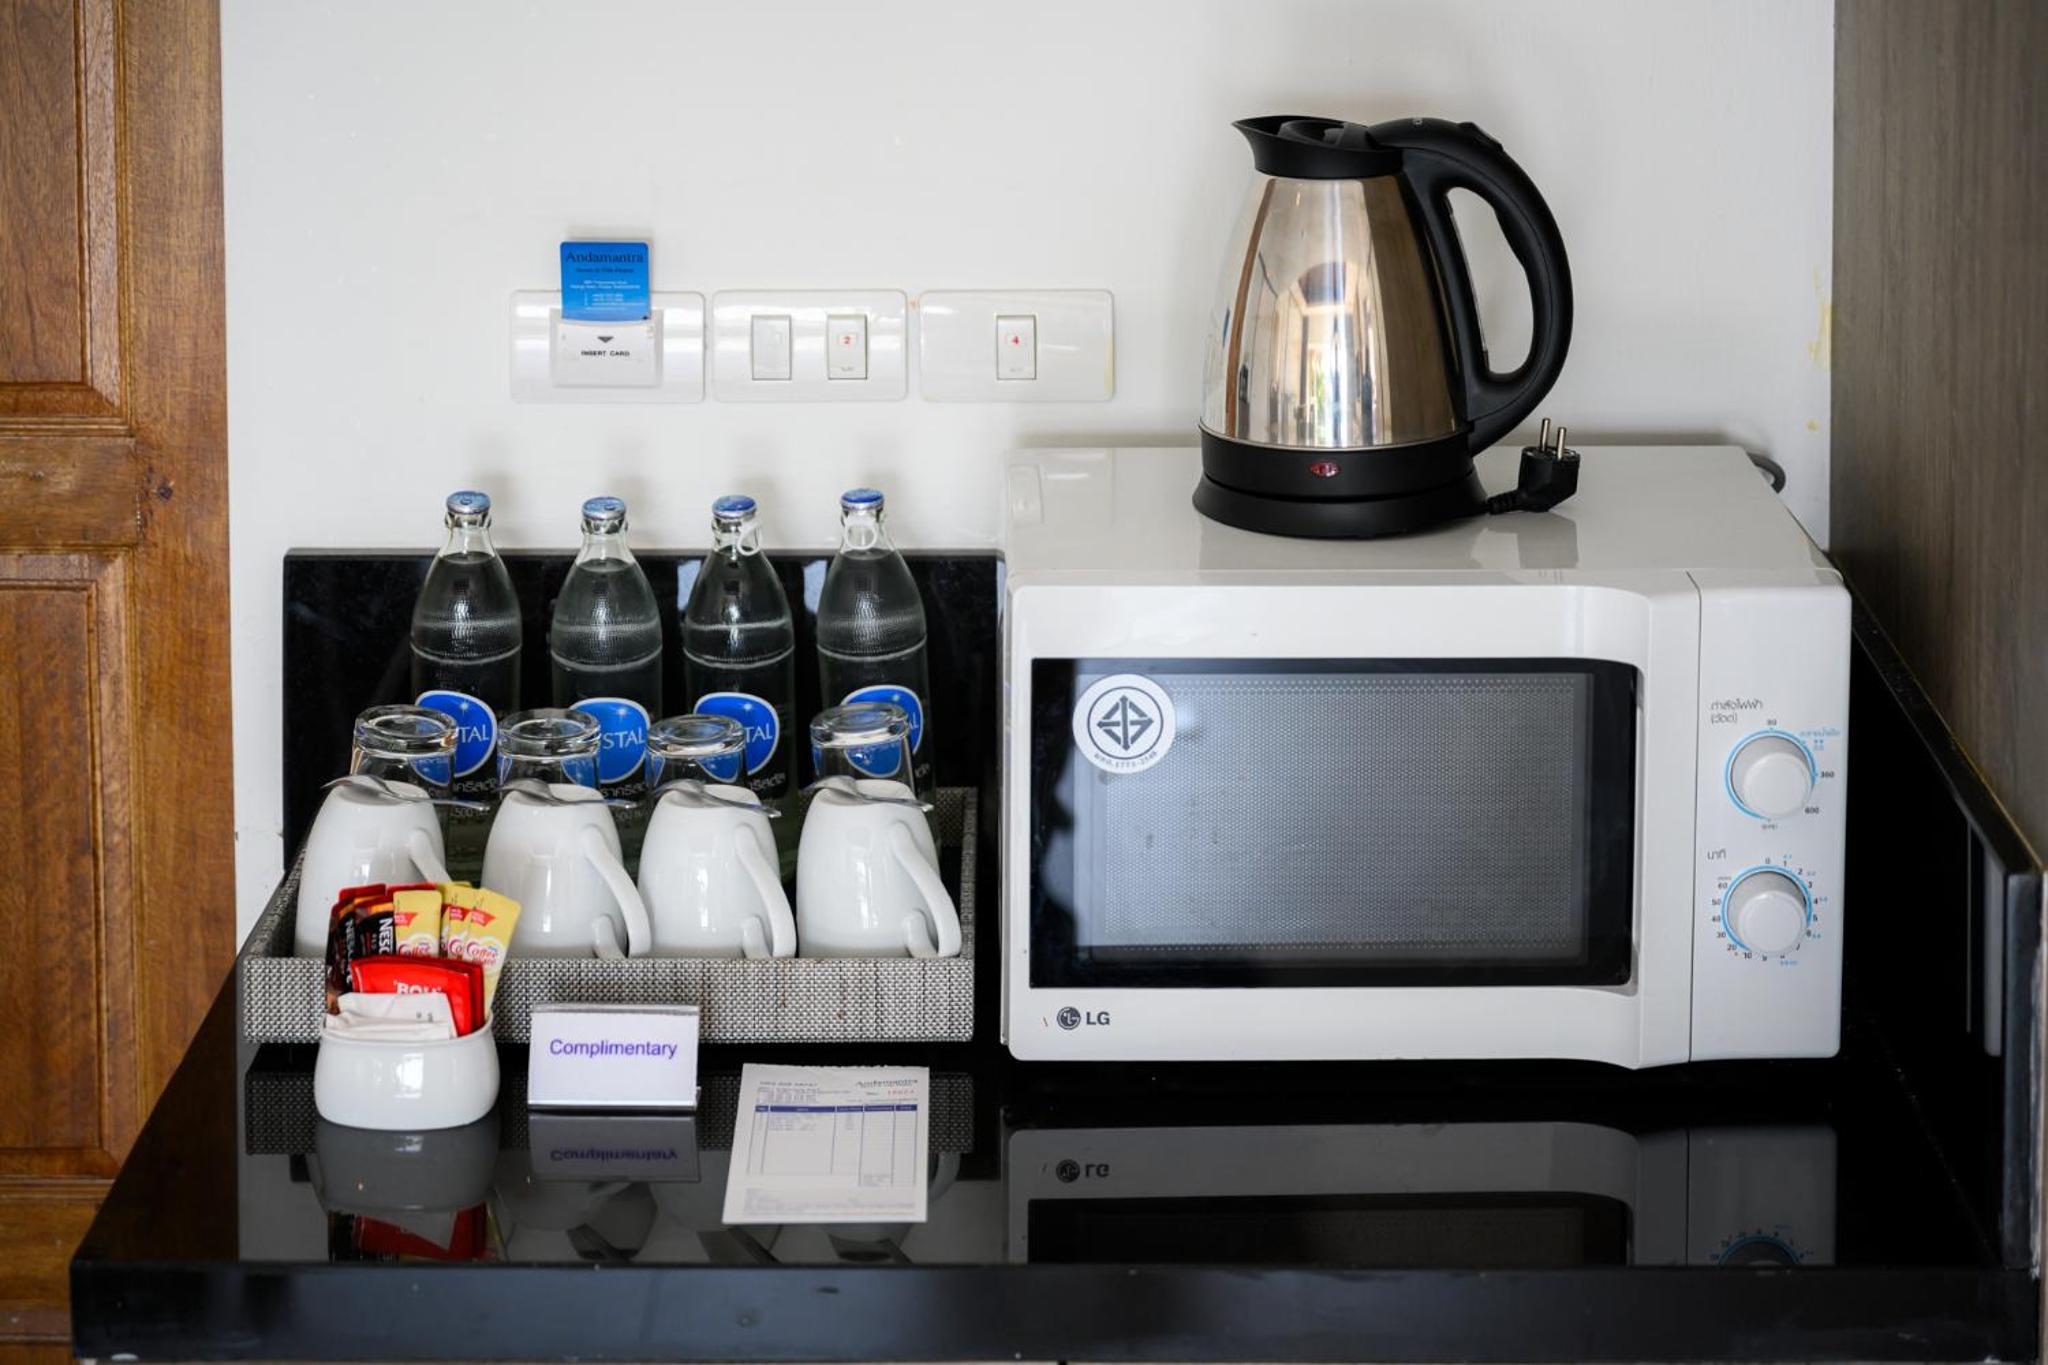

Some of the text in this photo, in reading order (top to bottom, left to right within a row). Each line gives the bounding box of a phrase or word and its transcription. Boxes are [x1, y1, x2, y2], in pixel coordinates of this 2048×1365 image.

[566, 250, 644, 264] Andamantra
[455, 724, 490, 743] TAL
[599, 727, 646, 750] STAL
[743, 723, 773, 743] TAL
[379, 917, 393, 955] NESC
[1743, 951, 1753, 959] 10
[1086, 1011, 1111, 1026] LG
[549, 1038, 678, 1060] Complimentary
